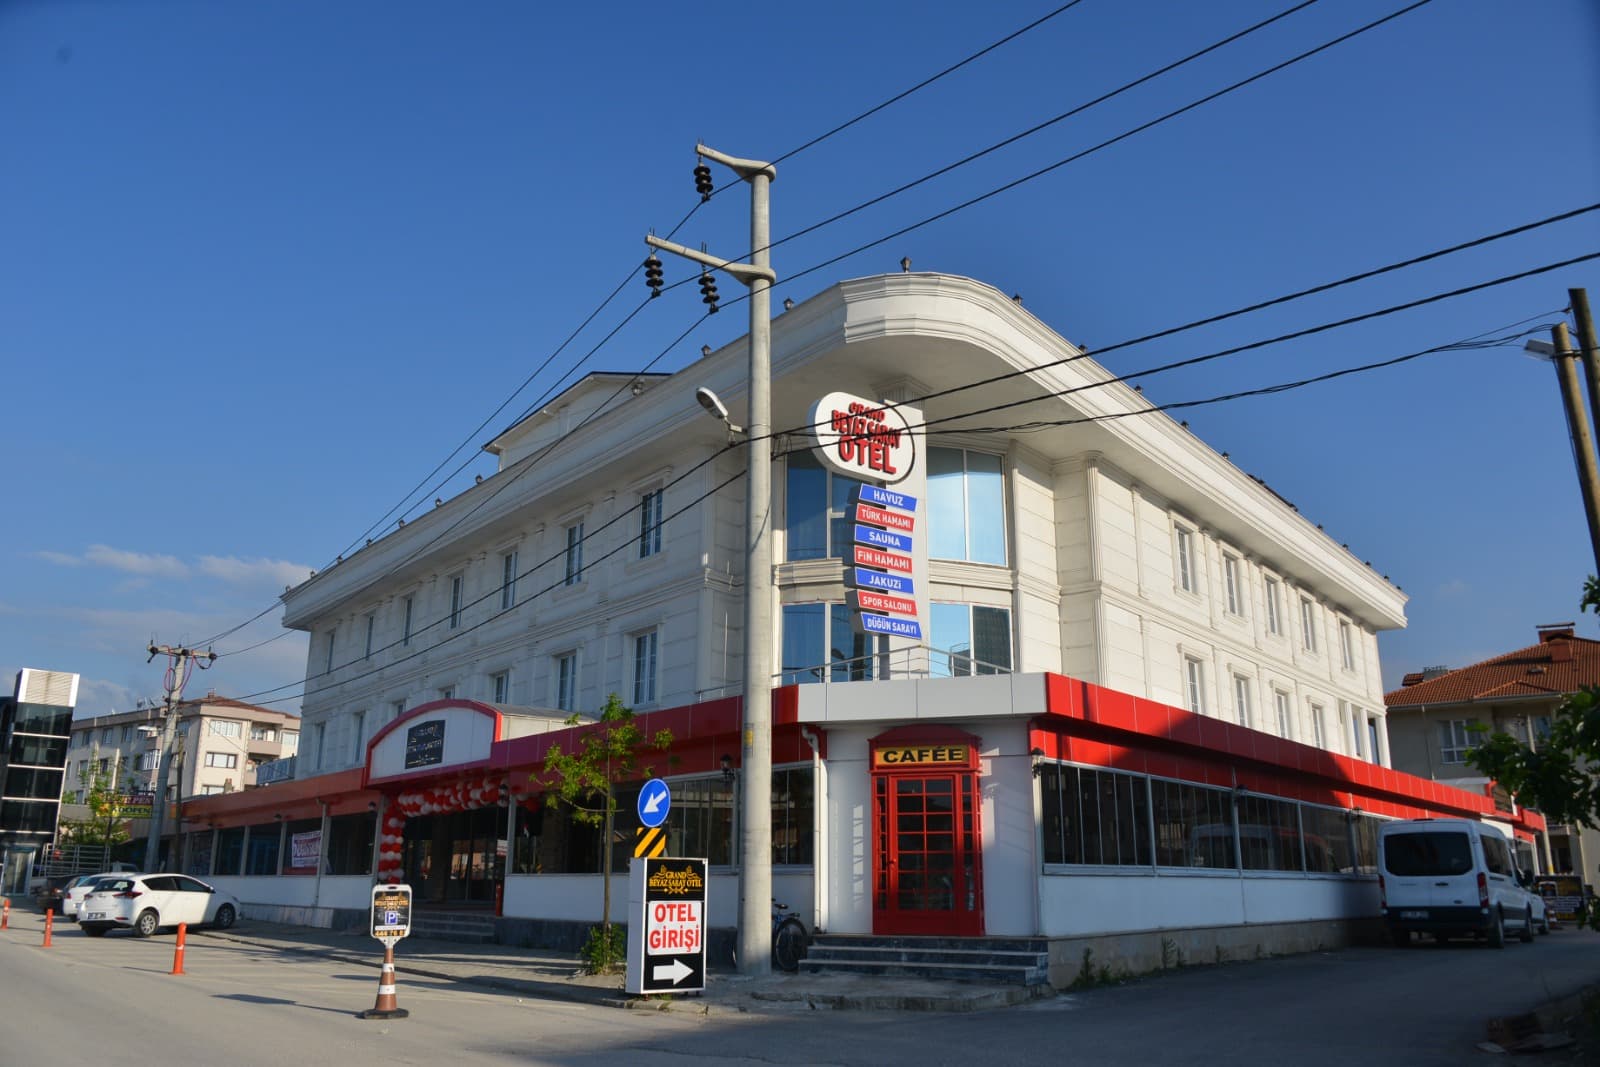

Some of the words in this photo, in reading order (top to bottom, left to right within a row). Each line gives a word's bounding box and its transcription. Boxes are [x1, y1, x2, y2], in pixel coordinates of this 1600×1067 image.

[849, 403, 885, 424] GRAND
[832, 411, 868, 437] BEYAZ
[838, 435, 897, 475] OTEL
[873, 489, 904, 506] HAVUZ
[861, 508, 881, 522] TÜRK
[882, 514, 911, 529] HAMAMI
[868, 531, 901, 547] SAUNA
[874, 555, 909, 569] HAMAMI
[863, 596, 882, 608] SPOR
[884, 600, 912, 612] SALONU
[867, 616, 891, 631] DÜĞÜN
[892, 622, 917, 635] SARAYI
[883, 745, 963, 763] CAFÉE
[687, 879, 702, 887] OTEL
[655, 903, 696, 922] OTEL
[649, 925, 700, 952] GİRİŞİ
